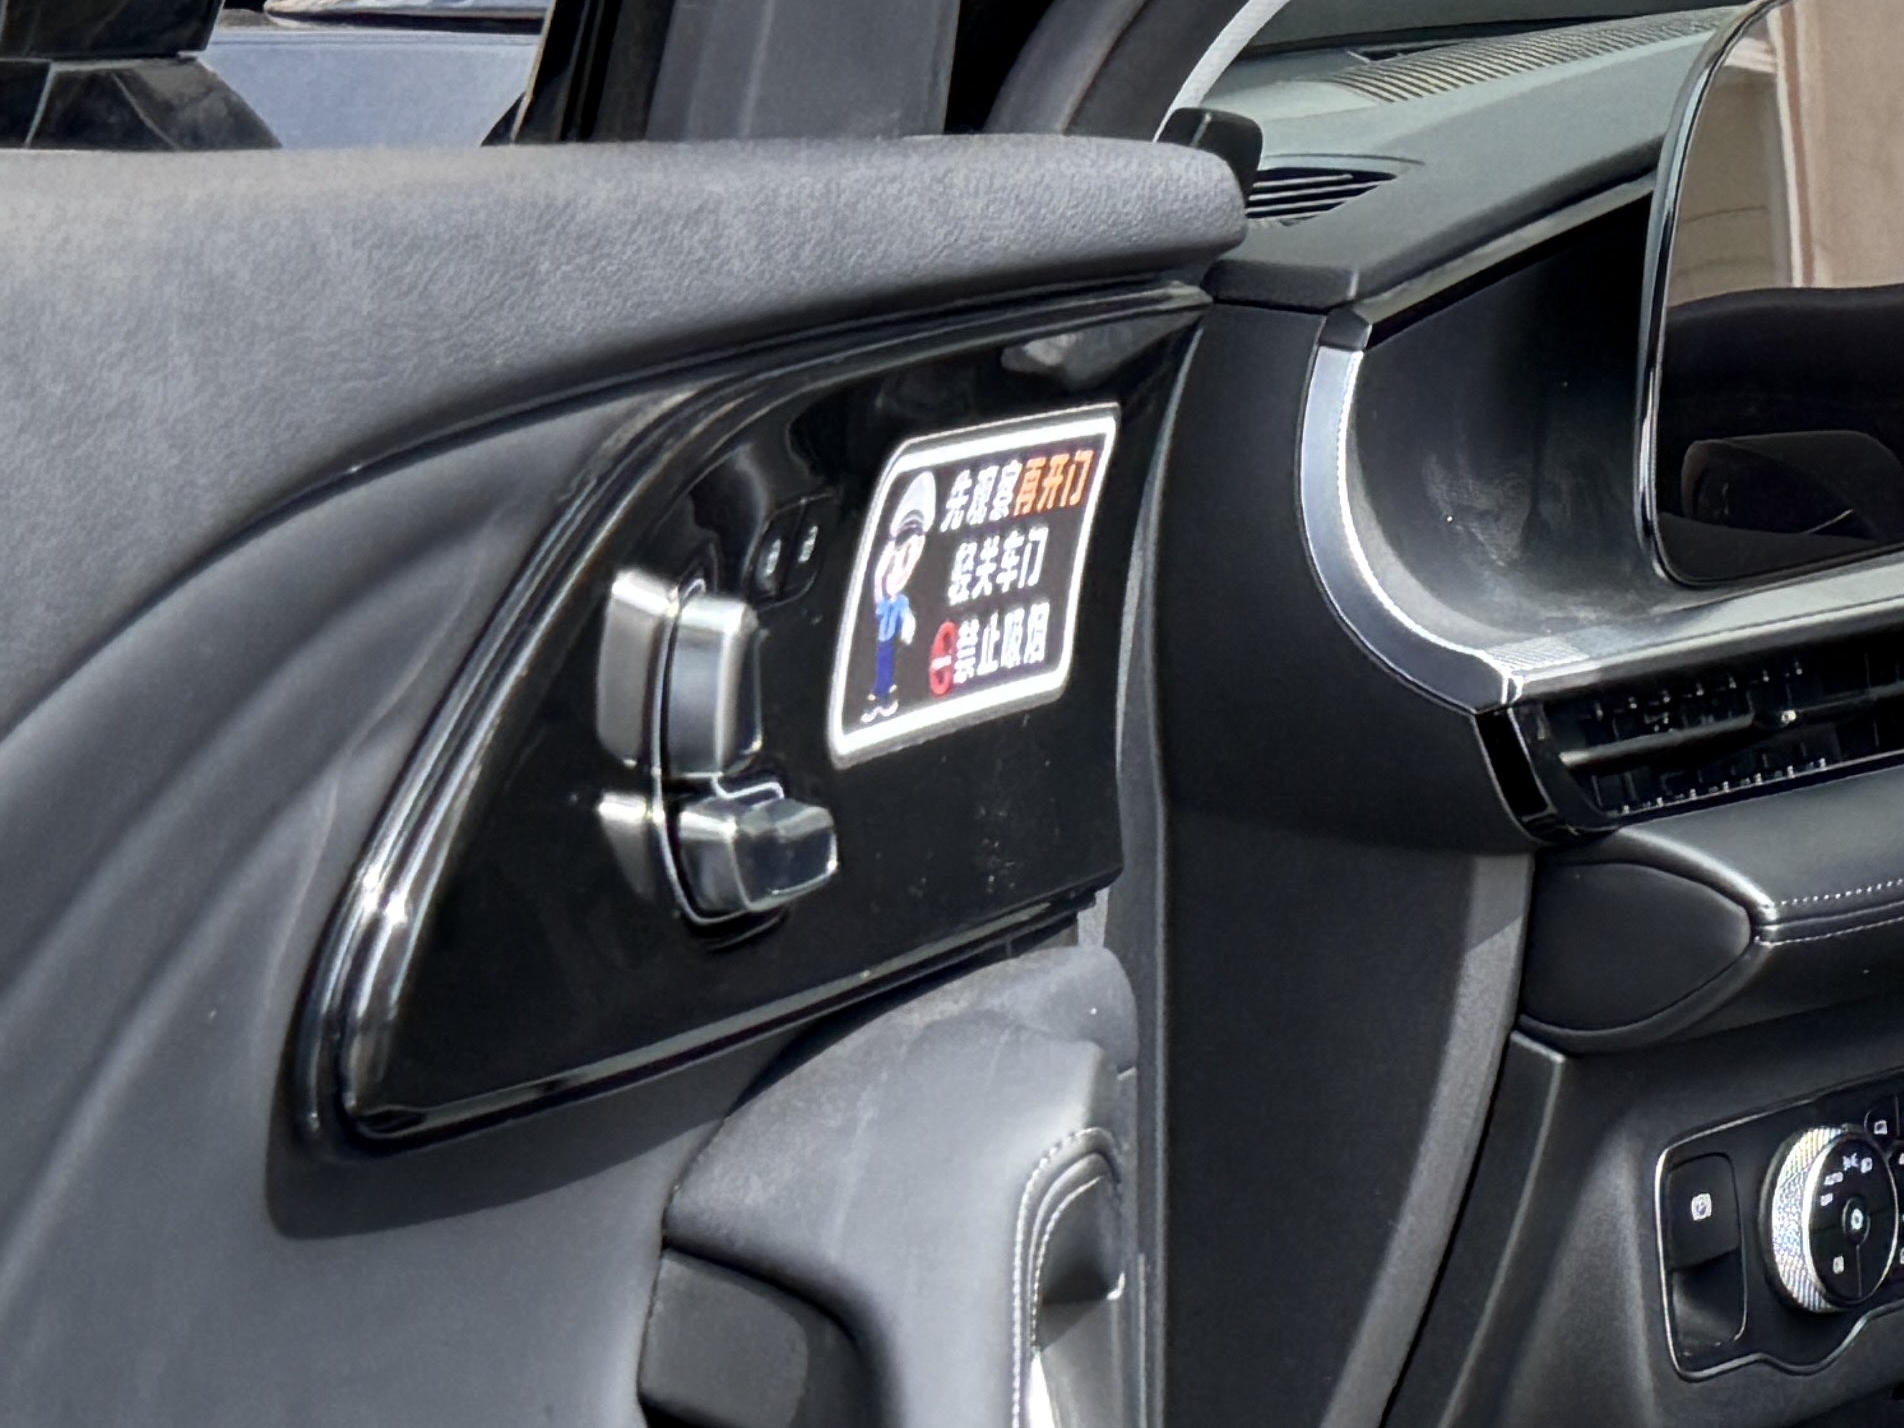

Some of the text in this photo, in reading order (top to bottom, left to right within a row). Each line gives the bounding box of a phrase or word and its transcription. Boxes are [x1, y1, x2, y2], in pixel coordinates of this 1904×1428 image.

[940, 449, 1094, 533] 先观察再开门
[948, 525, 1050, 606] 轻关车门
[953, 603, 1050, 685] 禁止吸烟
